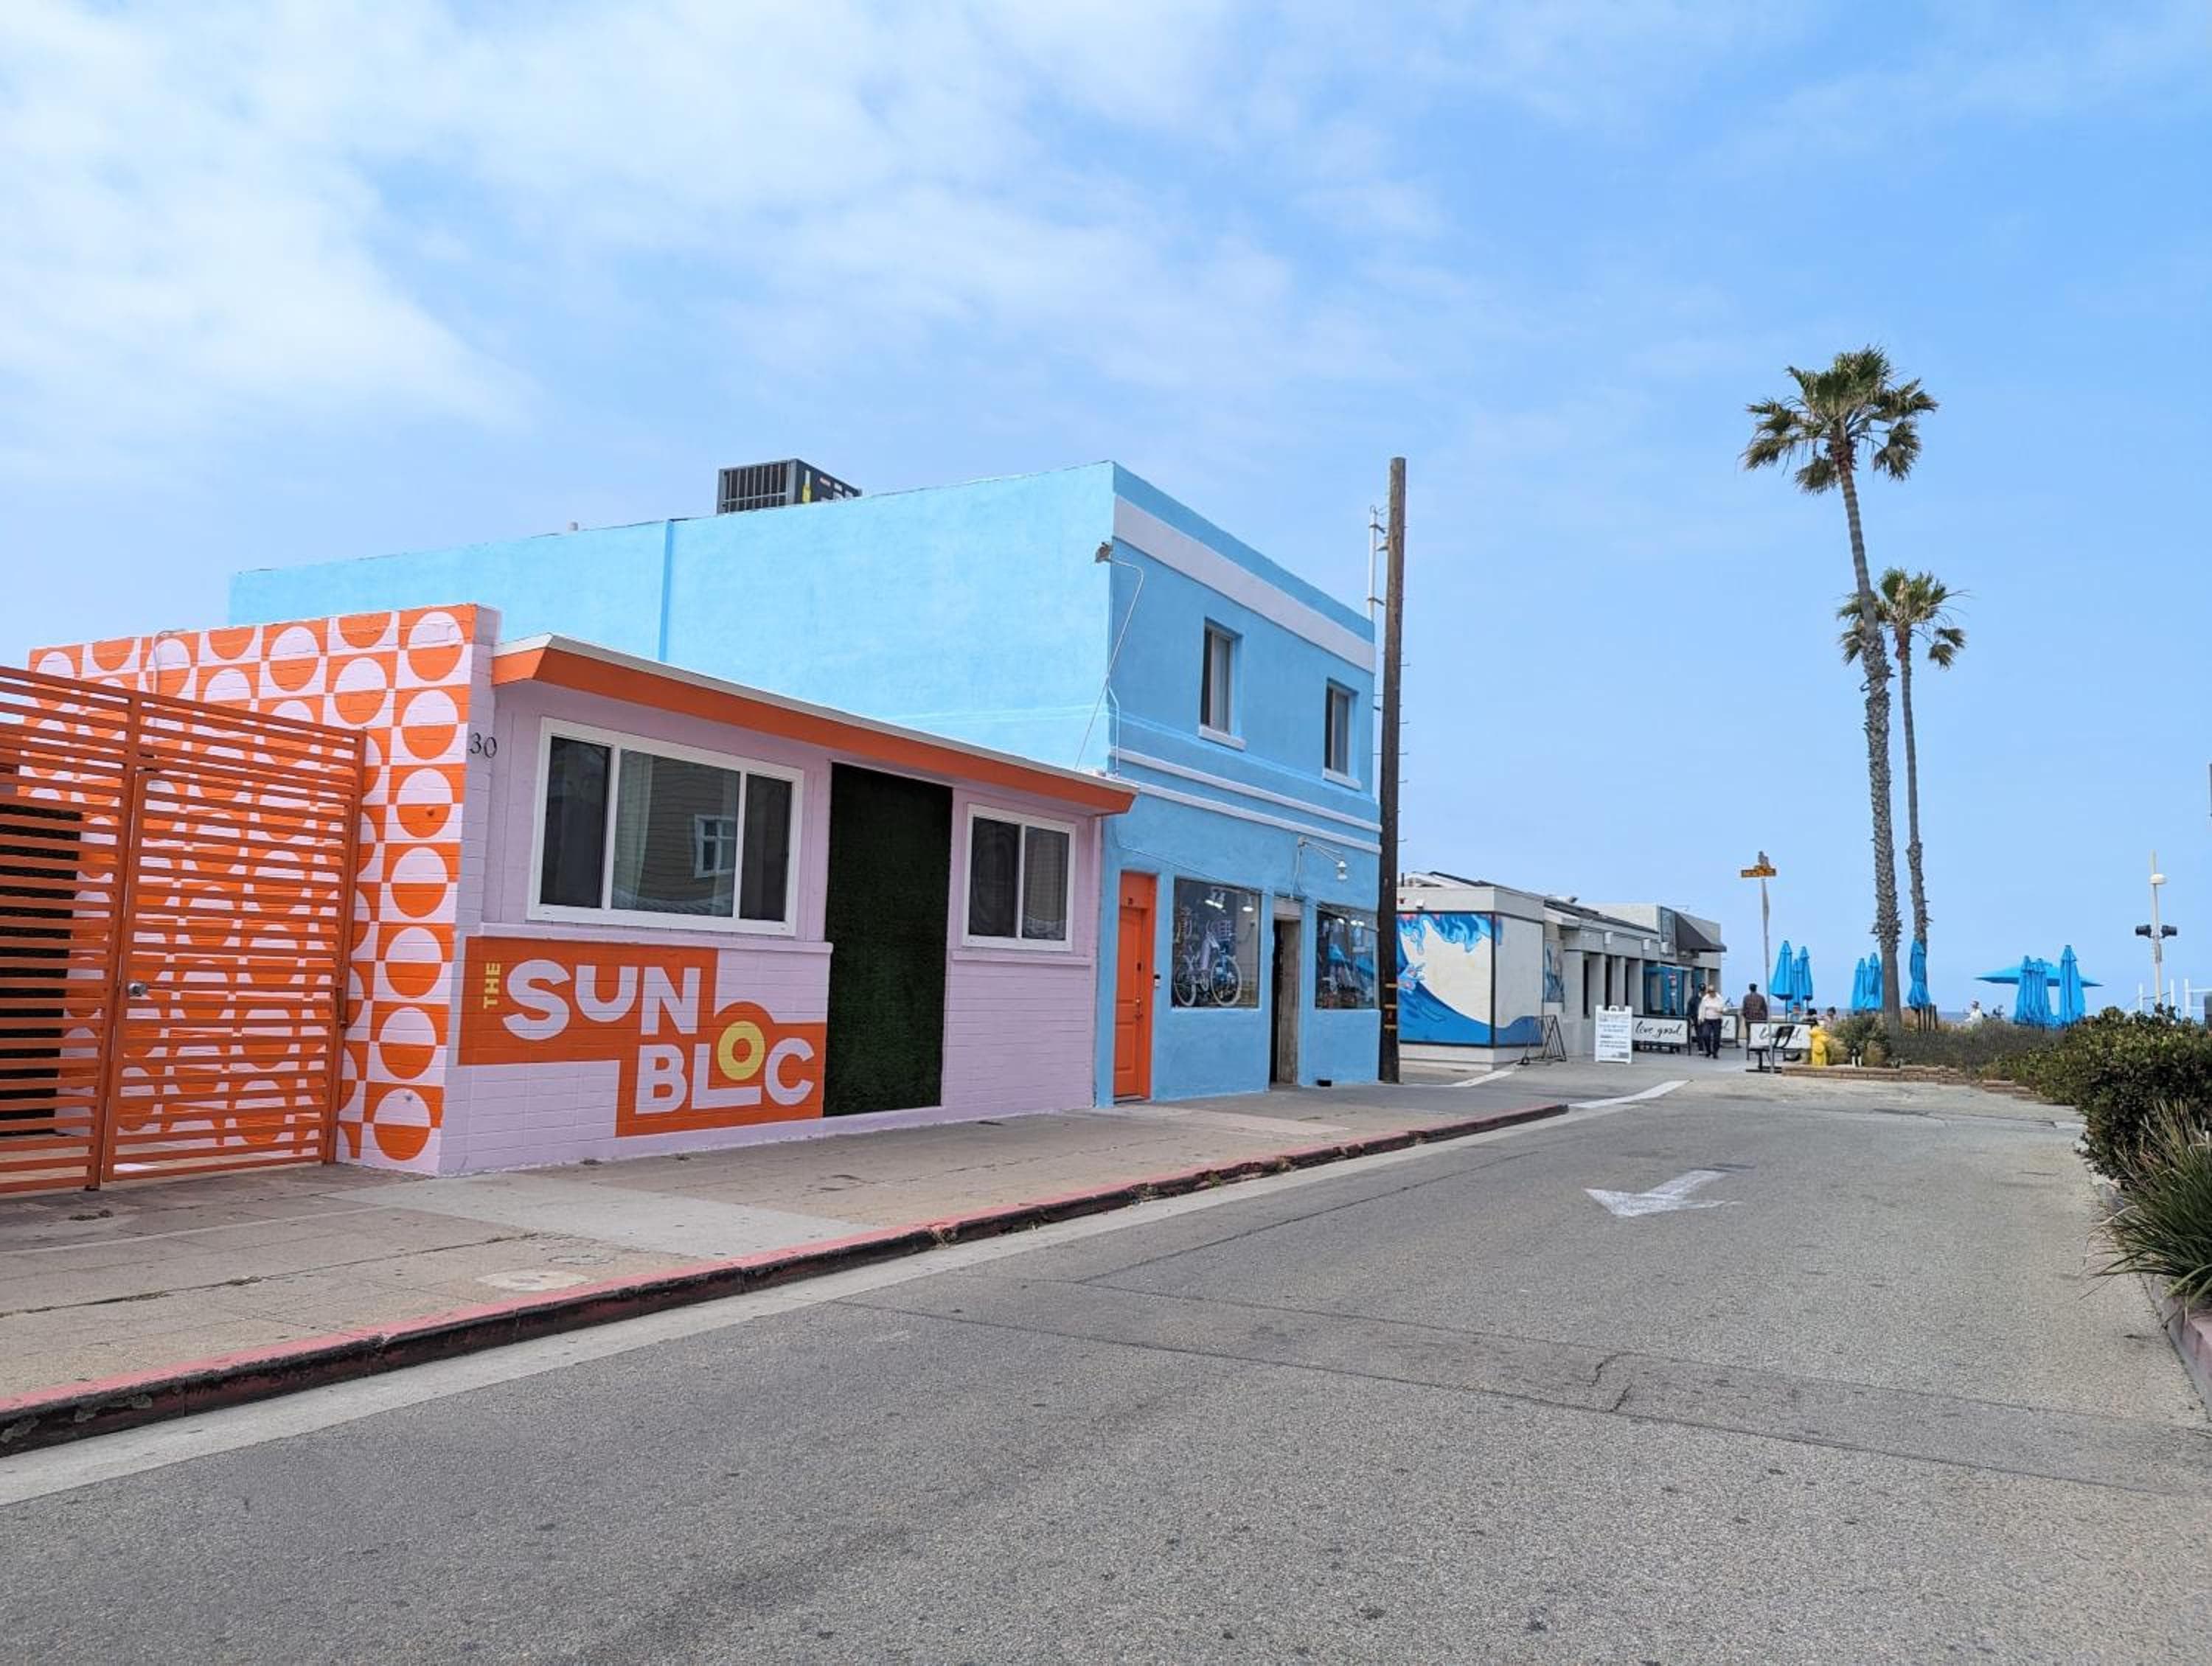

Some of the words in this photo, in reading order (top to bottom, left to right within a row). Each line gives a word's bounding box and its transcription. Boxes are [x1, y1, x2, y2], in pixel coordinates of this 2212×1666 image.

[470, 732, 498, 759] 30
[483, 962, 501, 1008] THE
[502, 959, 701, 1040] SUN
[635, 1020, 815, 1115] BLOC
